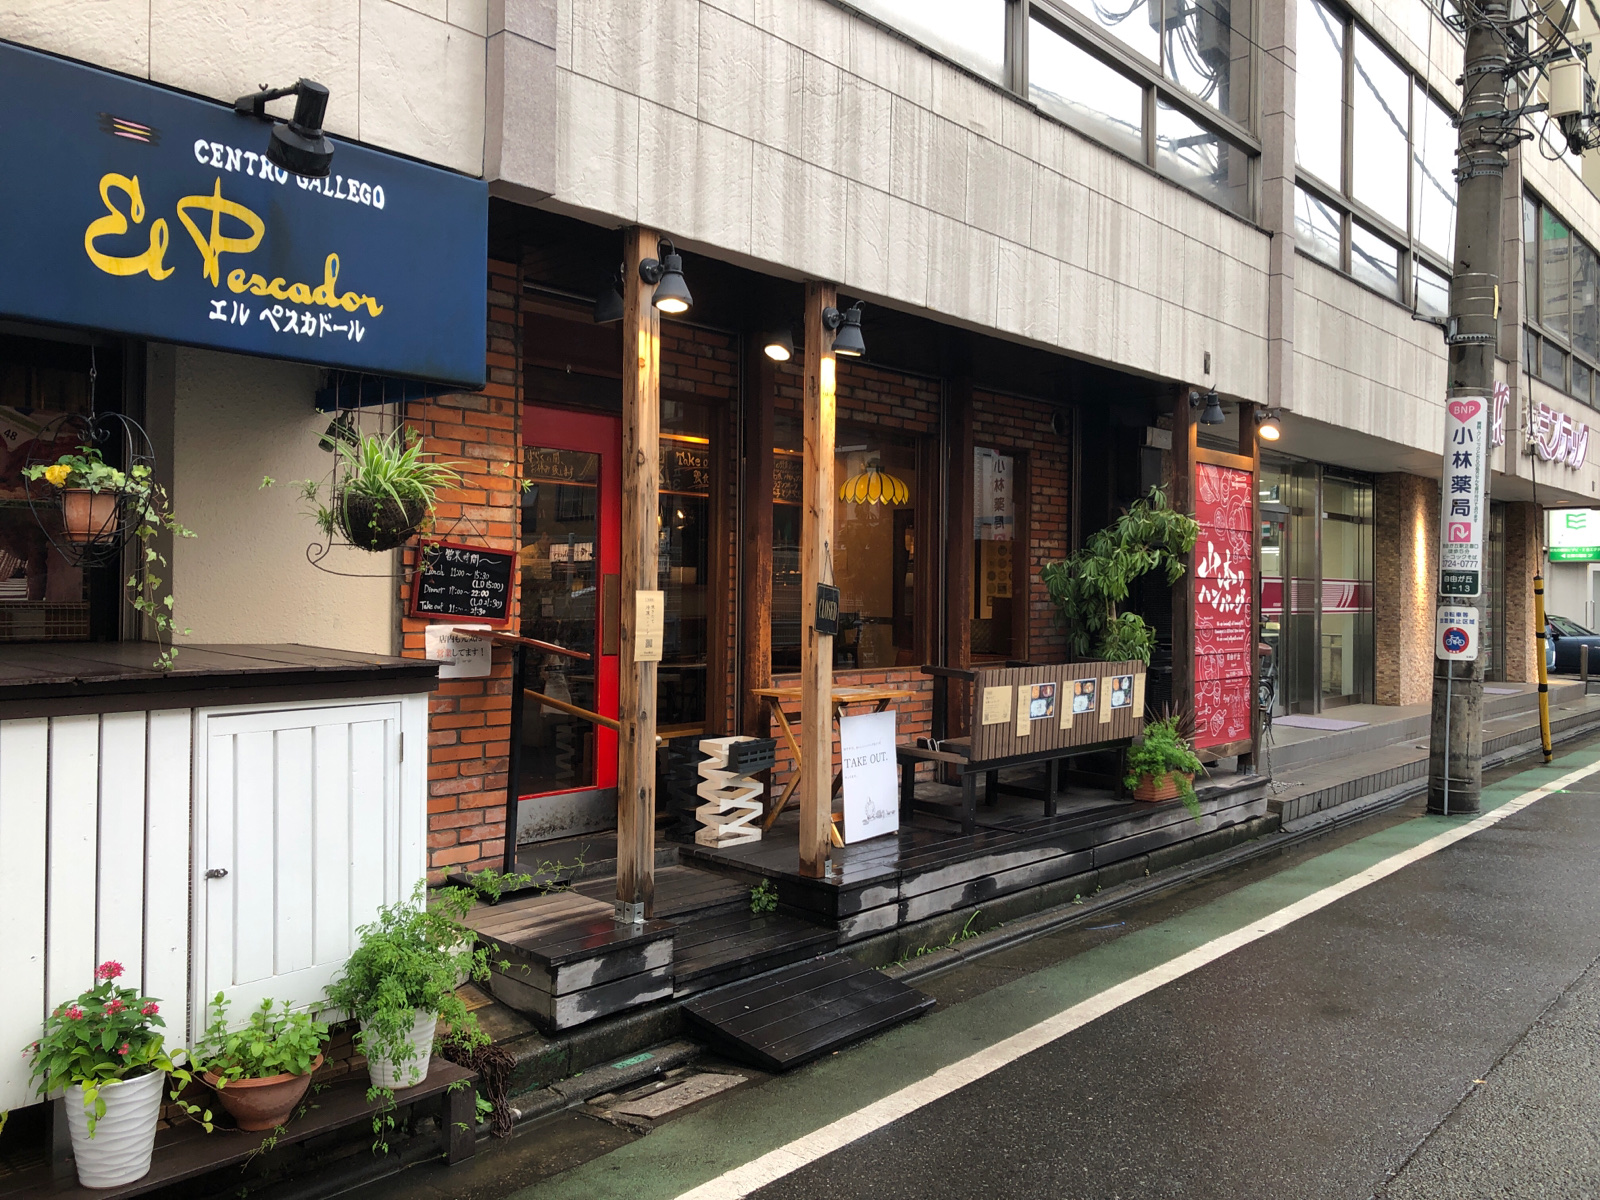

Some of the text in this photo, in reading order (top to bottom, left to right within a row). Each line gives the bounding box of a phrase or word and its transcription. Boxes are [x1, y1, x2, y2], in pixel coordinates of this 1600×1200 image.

[194, 139, 288, 185] CENTRO
[85, 173, 383, 318] El Pescador
[209, 299, 365, 343] エル ペスカドール
[1453, 405, 1475, 415] BNP
[675, 451, 700, 467] Take
[1450, 426, 1474, 517] 小林薬局
[1443, 575, 1473, 583] 自由が丘
[843, 751, 889, 769] TAKE OUT.
